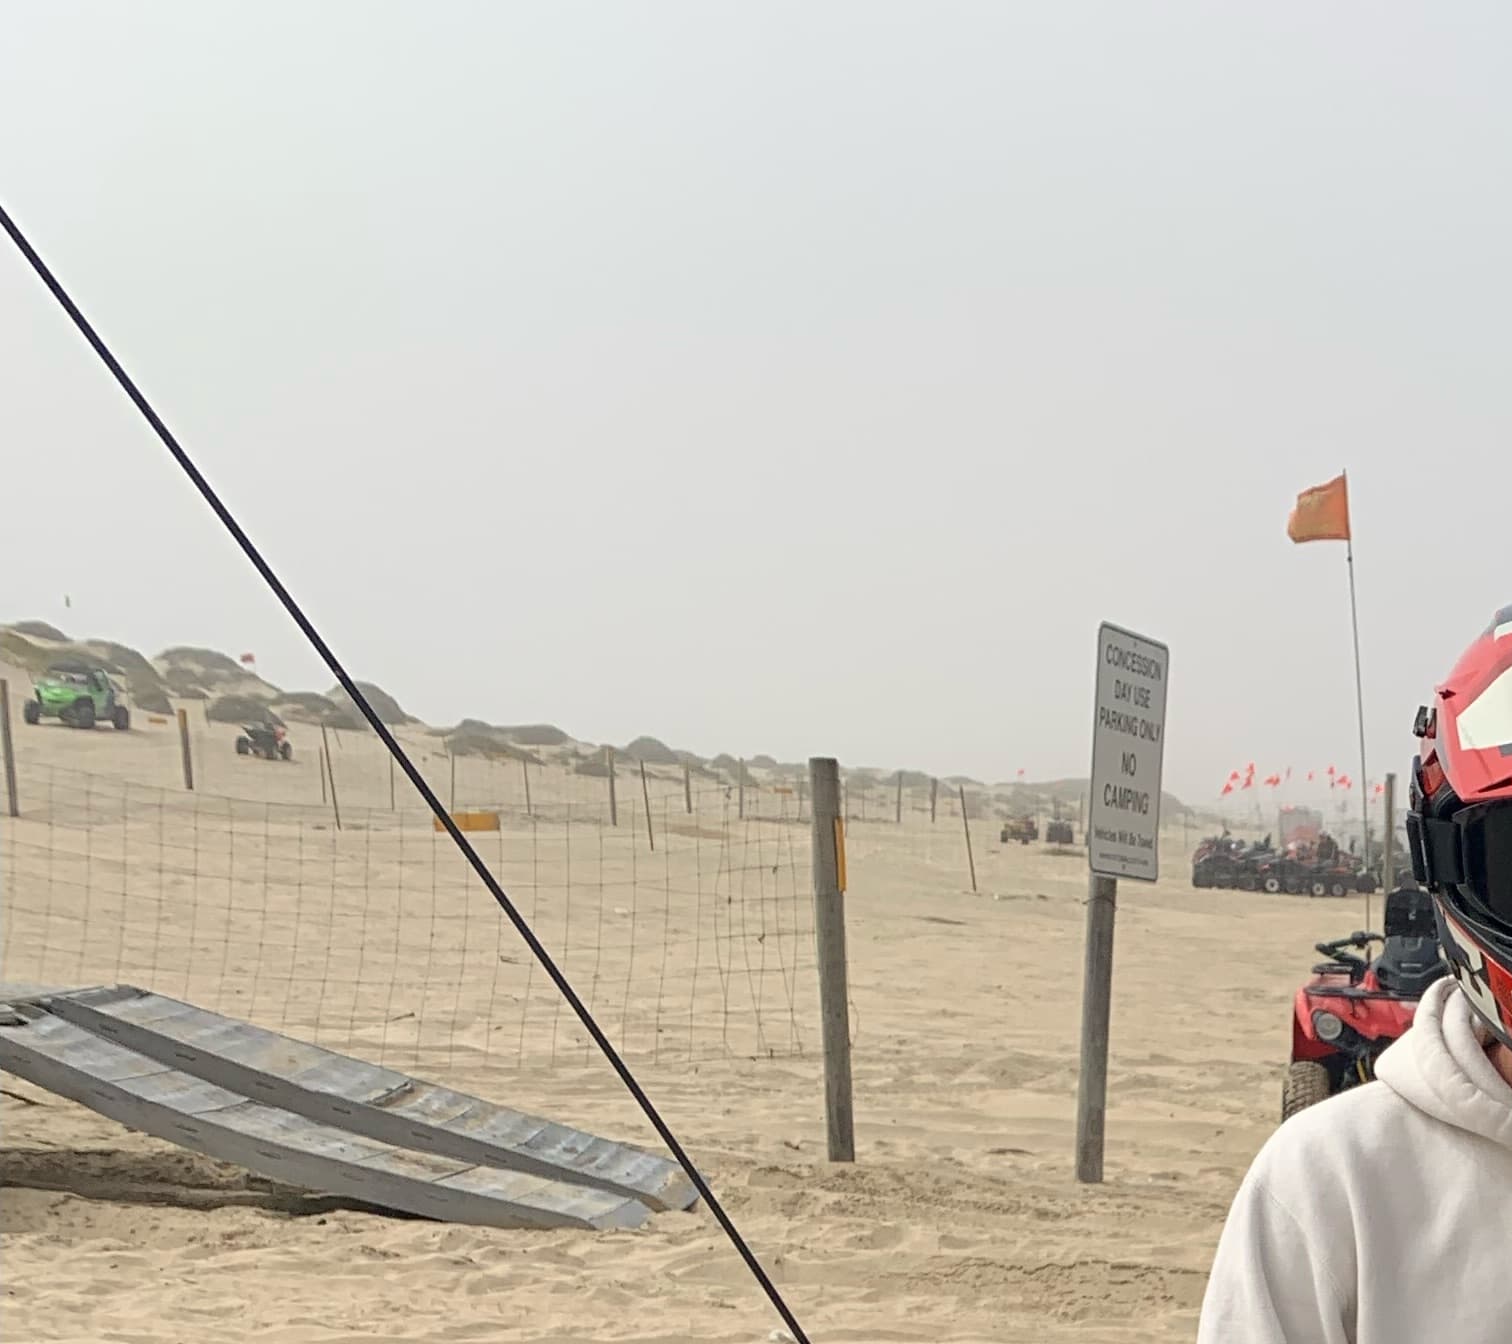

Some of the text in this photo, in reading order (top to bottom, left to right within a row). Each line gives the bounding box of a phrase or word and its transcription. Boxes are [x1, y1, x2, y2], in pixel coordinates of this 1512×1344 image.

[1105, 643, 1162, 681] CONCESSION
[1114, 679, 1151, 709] DAY USE
[1100, 706, 1138, 738] PARKING
[1121, 752, 1137, 777] NO
[1103, 783, 1149, 815] CAMPING
